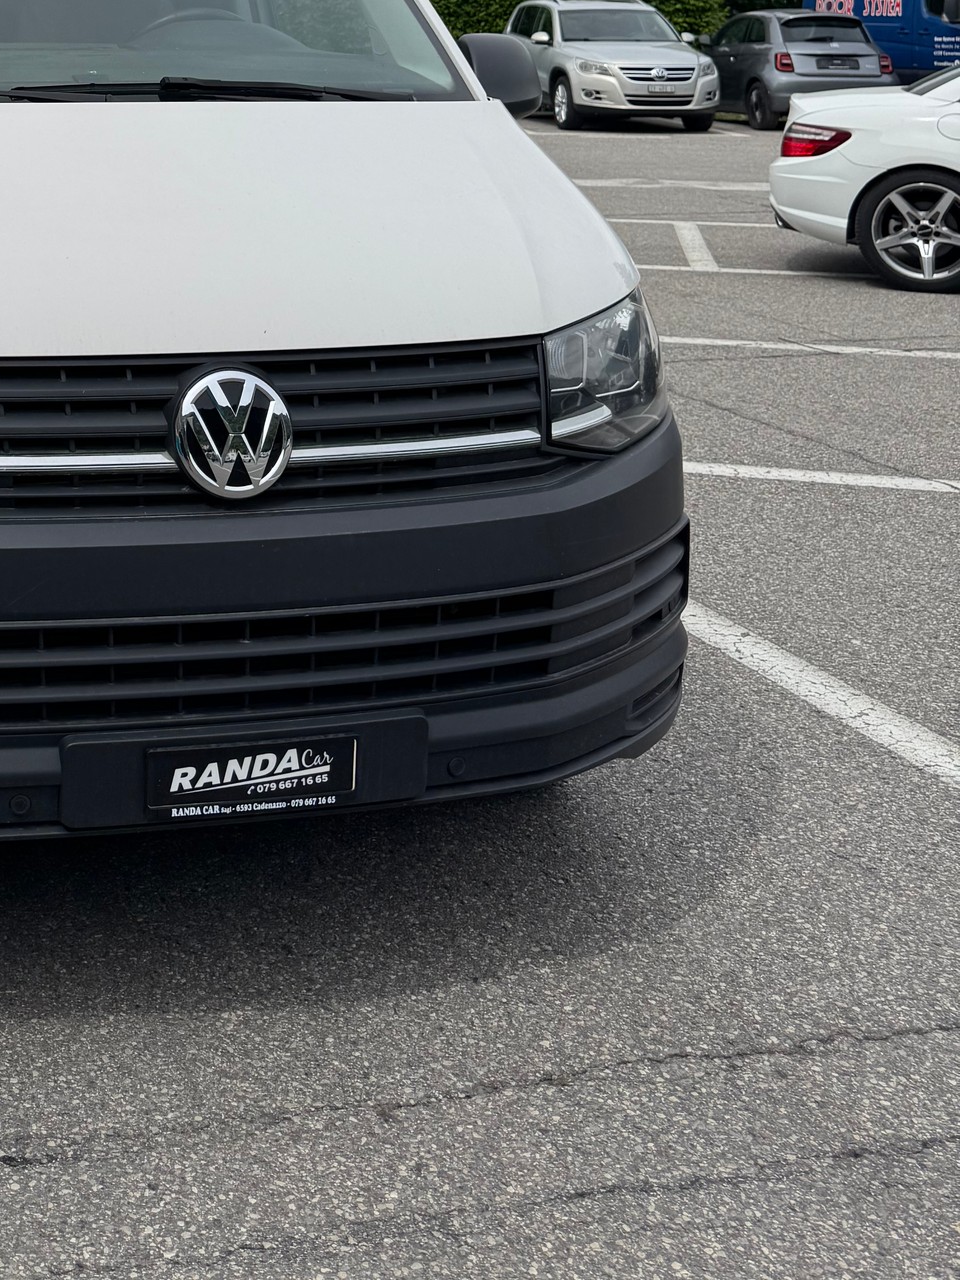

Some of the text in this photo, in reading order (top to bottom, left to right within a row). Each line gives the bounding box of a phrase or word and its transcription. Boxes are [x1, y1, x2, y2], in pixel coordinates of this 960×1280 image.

[169, 748, 334, 793] RANDA Car
[256, 773, 329, 793] 079 667 16 65
[171, 806, 202, 818] RANDA
[202, 804, 220, 815] CAR
[236, 803, 252, 813] 6593
[253, 800, 287, 811] Cadenazzo
[291, 799, 303, 808] 079
[304, 797, 317, 806] 667
[318, 796, 327, 805] 16
[328, 795, 336, 804] 65
